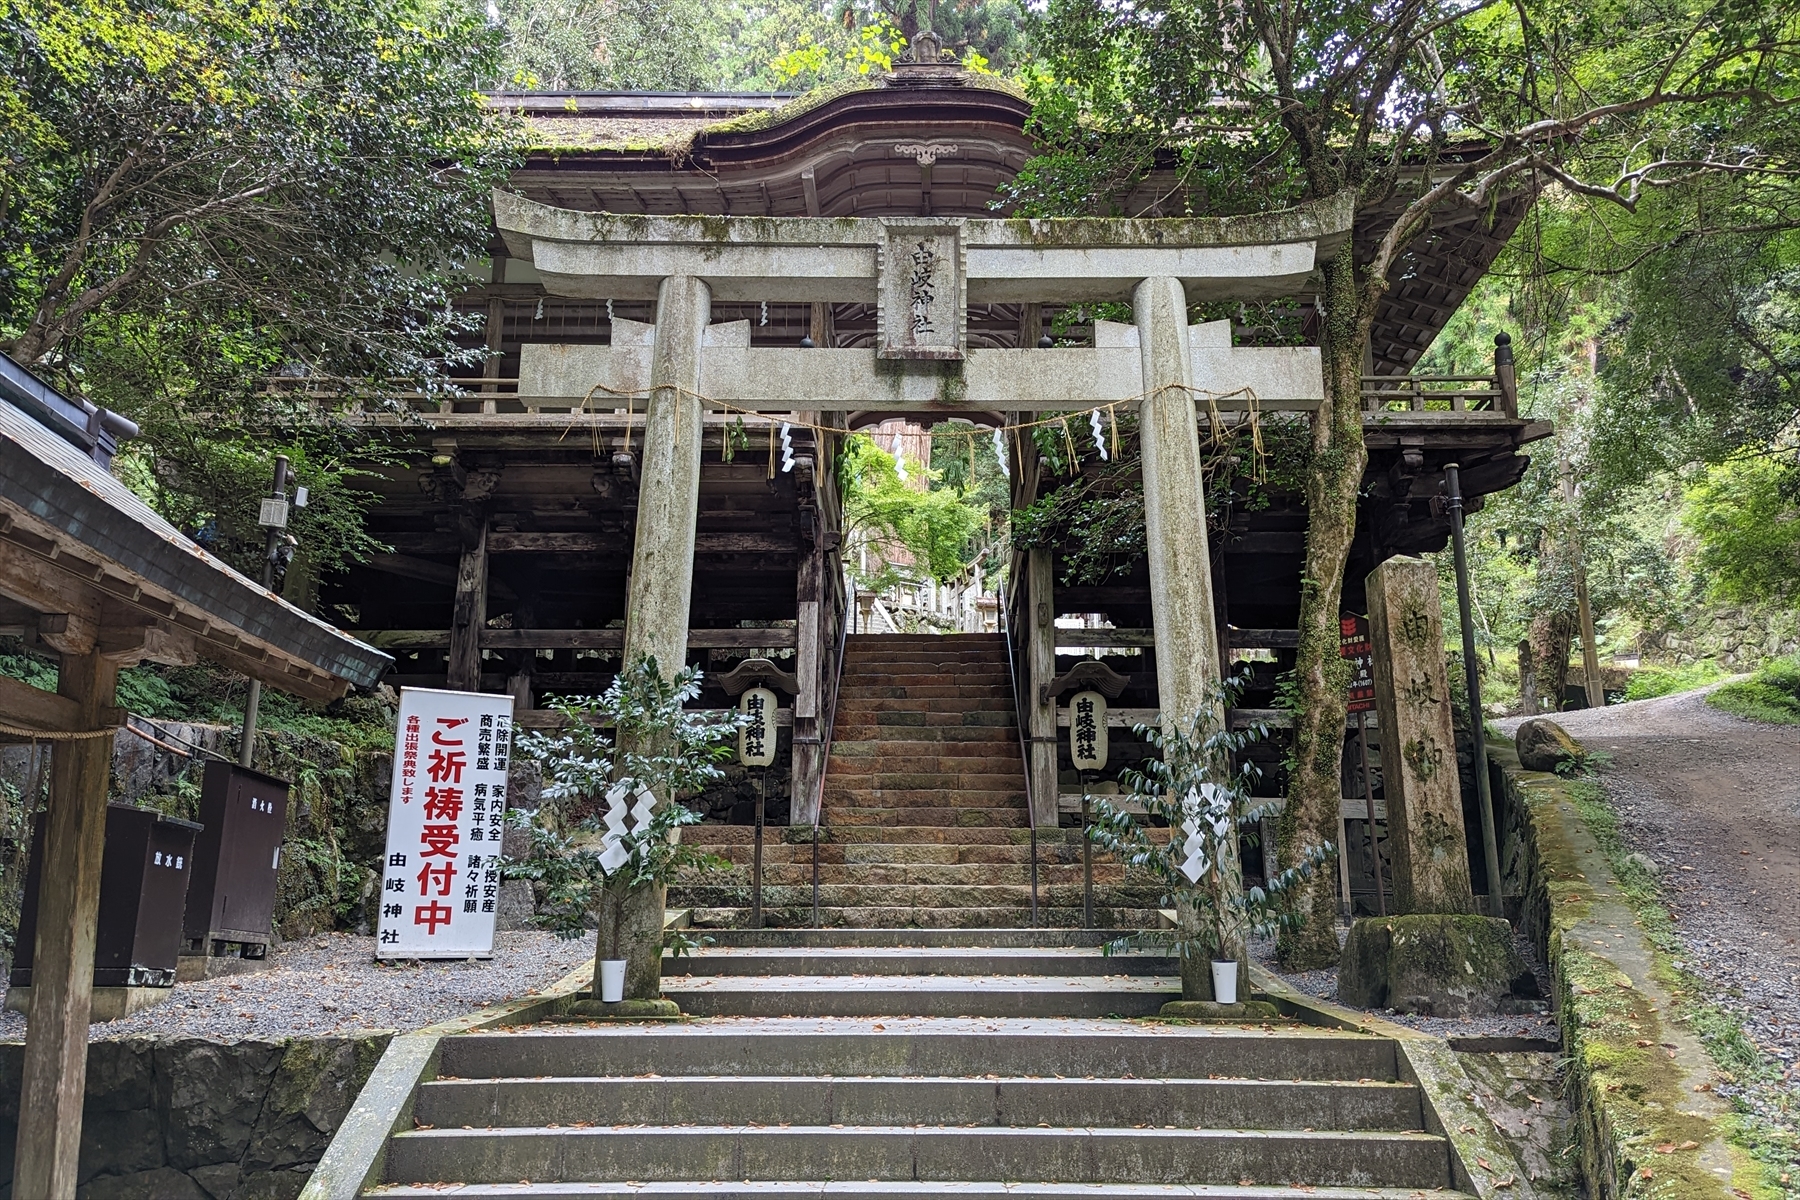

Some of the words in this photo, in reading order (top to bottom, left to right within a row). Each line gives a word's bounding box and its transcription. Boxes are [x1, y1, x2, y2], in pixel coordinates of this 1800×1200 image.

[910, 242, 935, 334] 由岐神社
[1340, 635, 1365, 646] 化財愛護
[476, 714, 494, 771] 商売繁盛
[745, 693, 766, 758] 由岐神社
[1075, 697, 1097, 761] 由岐神社
[400, 715, 421, 804] 各種出張祭典致します
[413, 717, 470, 936] ご祈祷受付中
[470, 783, 488, 842] 病気平癒
[487, 784, 505, 842] 家内安全
[380, 852, 407, 945] 由岐神社
[463, 854, 482, 914] 諸々祈願
